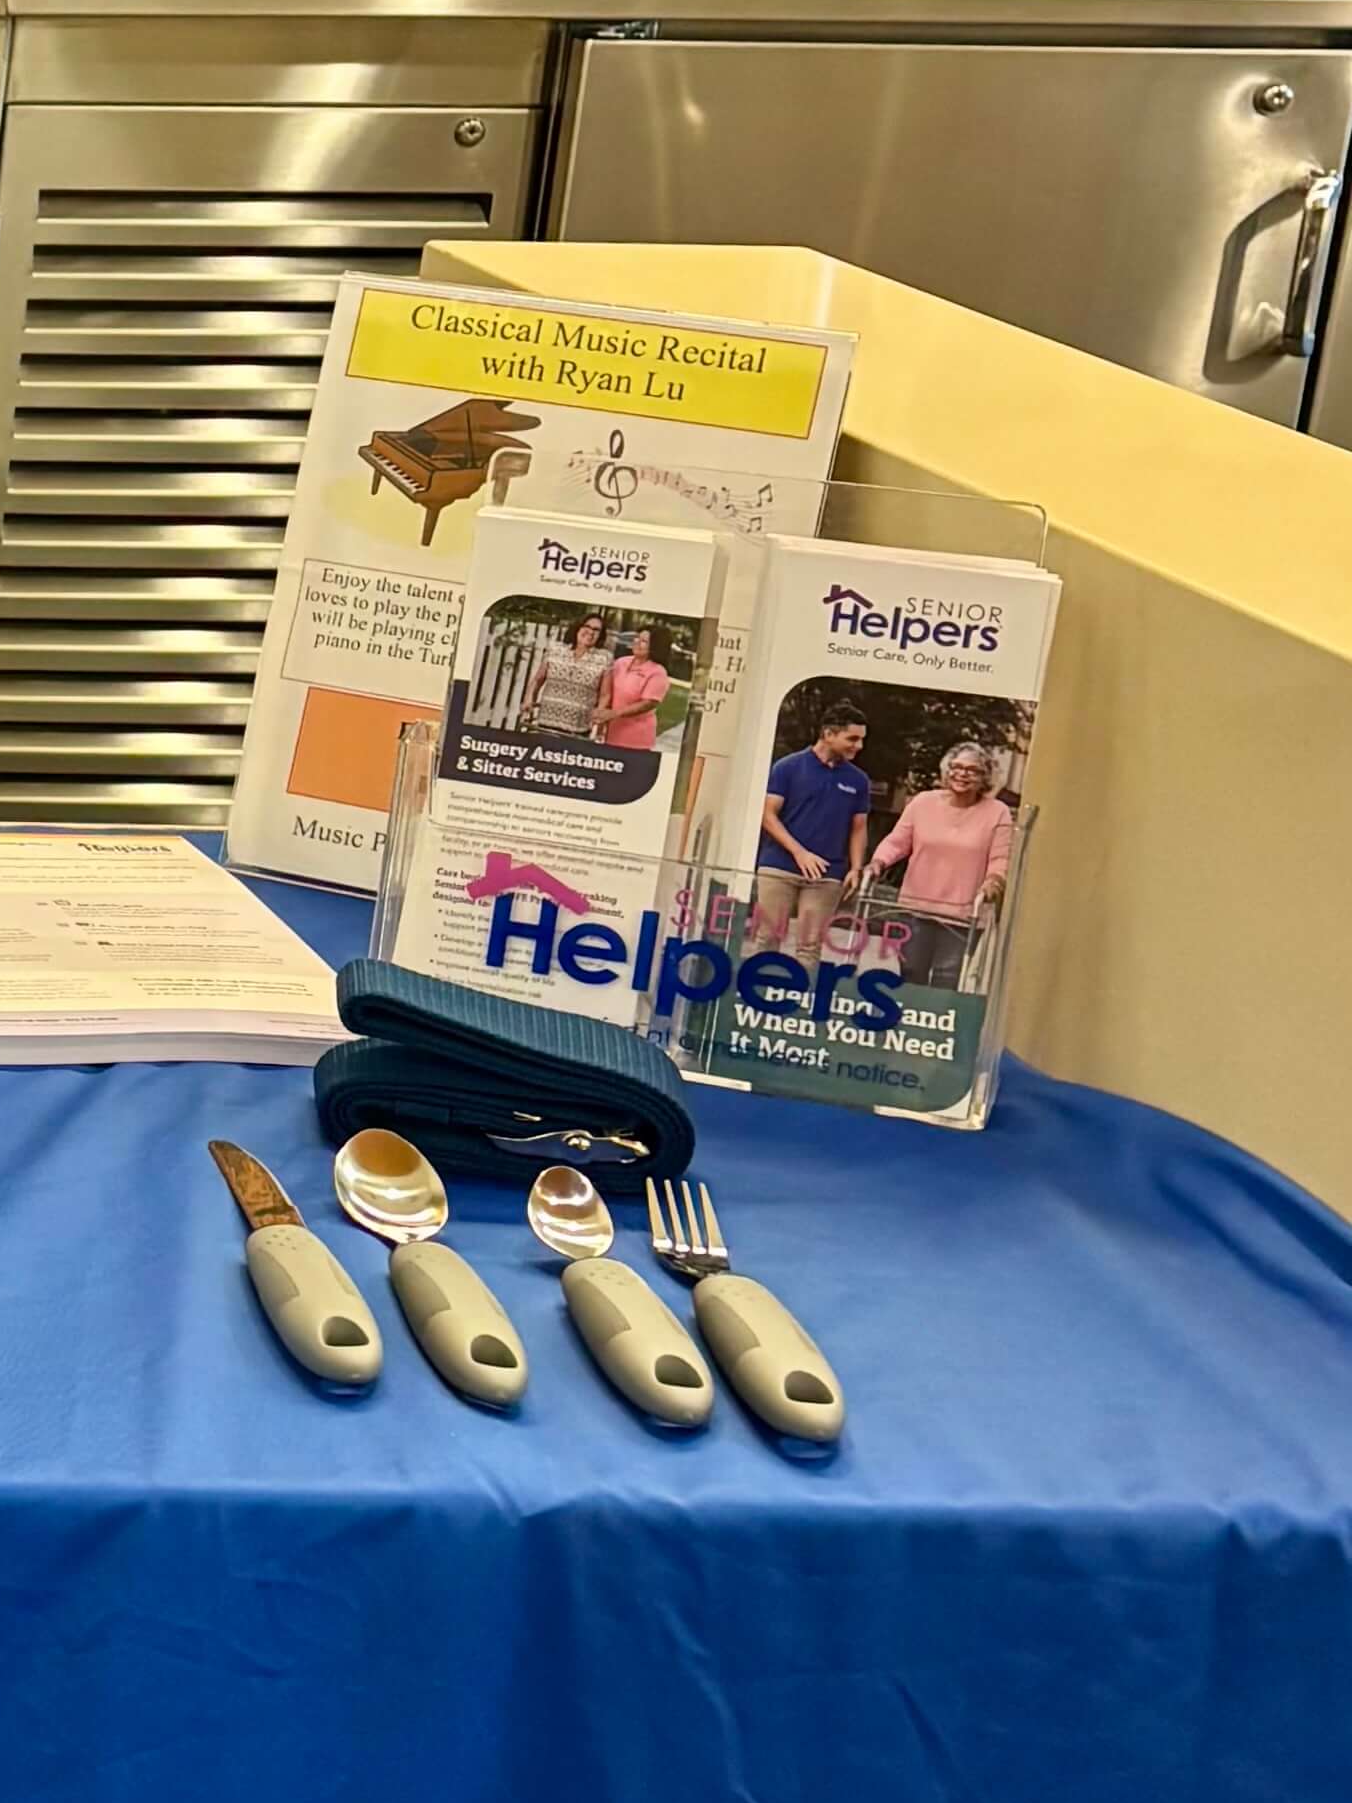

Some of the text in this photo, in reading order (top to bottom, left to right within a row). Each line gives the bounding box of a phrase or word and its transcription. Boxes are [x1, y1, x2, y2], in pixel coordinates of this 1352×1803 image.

[411, 304, 768, 374] Classical Music Recital
[481, 352, 686, 402] with Ryan Lu
[542, 550, 648, 582] Helpers
[590, 545, 650, 564] SENIOR
[322, 567, 454, 603] Enjoy the talent
[304, 586, 441, 623] loves to play the
[905, 597, 1003, 623] SENIOR
[312, 611, 436, 646] will be playing
[830, 602, 1000, 652] Helpers
[313, 631, 414, 660] piano in the
[827, 642, 994, 673] Senior Care, Only Better.
[704, 698, 726, 713] of
[460, 735, 624, 773] Surgery Assistance
[456, 756, 596, 791] & Sitter Services
[292, 815, 364, 849] Music
[670, 888, 913, 961] SENIOR
[485, 891, 906, 1031] Helpers
[734, 1003, 955, 1061] When You Need
[898, 1002, 956, 1032] and
[730, 1032, 751, 1055] It
[837, 1058, 925, 1092] notice.
